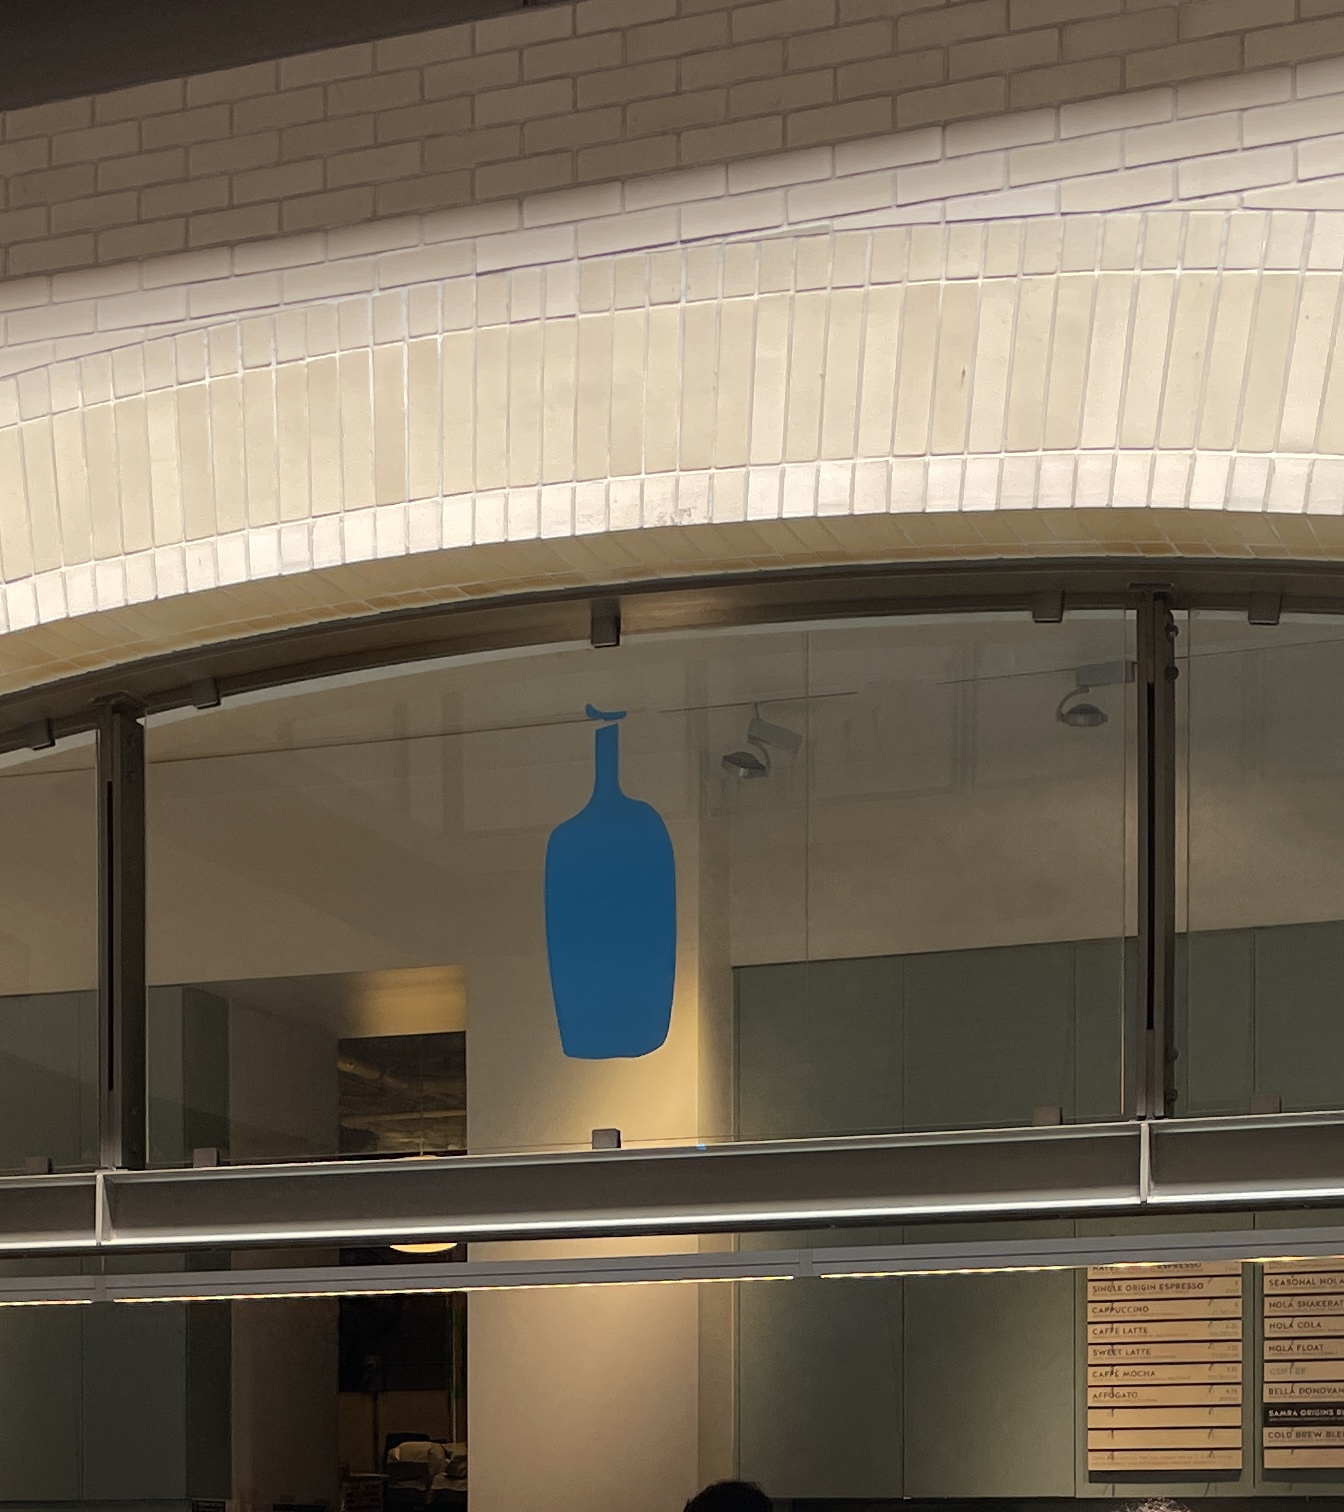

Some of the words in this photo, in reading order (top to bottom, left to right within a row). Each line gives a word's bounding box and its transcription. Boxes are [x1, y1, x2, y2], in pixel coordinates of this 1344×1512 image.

[1269, 1278, 1316, 1287] SEASONAL
[1320, 1277, 1344, 1285] NOLA
[1159, 1282, 1204, 1291] ESPRESSO
[1092, 1305, 1150, 1313] CAPPUCCINO
[1297, 1321, 1322, 1329] COLA
[1123, 1326, 1148, 1334] LATTE
[1093, 1348, 1122, 1356] SWEET
[1126, 1348, 1151, 1356] LATTE
[1297, 1344, 1324, 1352] FLOAT
[1268, 1387, 1295, 1395] BELLA
[1299, 1387, 1344, 1395] DONOVAN
[1268, 1431, 1293, 1439] COLD
